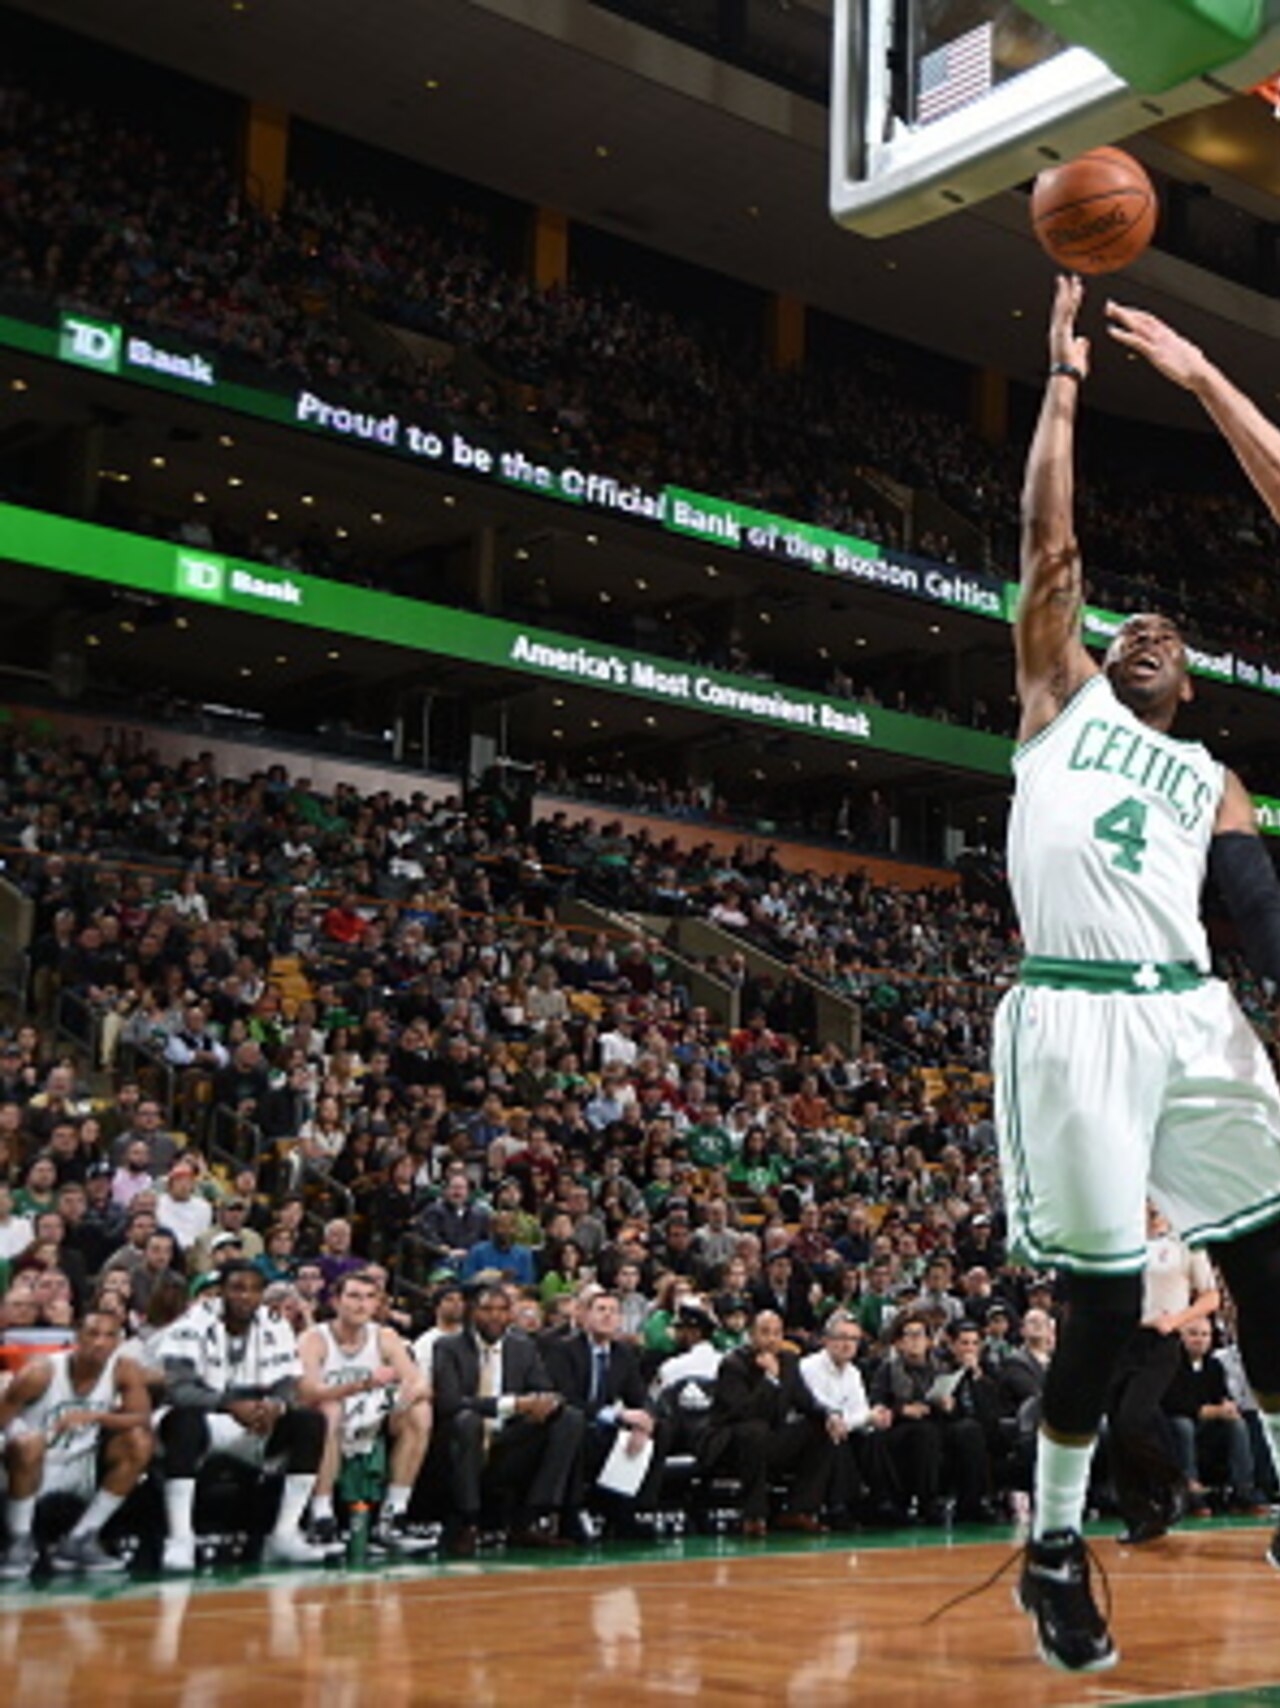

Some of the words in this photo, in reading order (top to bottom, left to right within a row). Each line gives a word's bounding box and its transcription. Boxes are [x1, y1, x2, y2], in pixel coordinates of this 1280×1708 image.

[64, 318, 114, 361] TD
[128, 337, 215, 386] Bank
[297, 391, 399, 446] Proud
[406, 424, 443, 458] to
[453, 433, 493, 473] be
[501, 451, 552, 490] the
[560, 467, 668, 520] Official
[673, 500, 741, 542] Bank
[748, 522, 781, 551] of
[785, 532, 827, 564] the
[833, 544, 918, 590] Boston
[925, 571, 1000, 612] Celtics
[181, 558, 220, 589] TD
[232, 570, 302, 605] Bank
[510, 635, 628, 684] America's
[631, 661, 690, 698] Most
[695, 677, 818, 726] Convenient
[820, 704, 870, 738] Bank
[1068, 717, 1212, 831] CELTICS
[1094, 795, 1148, 875] 4
